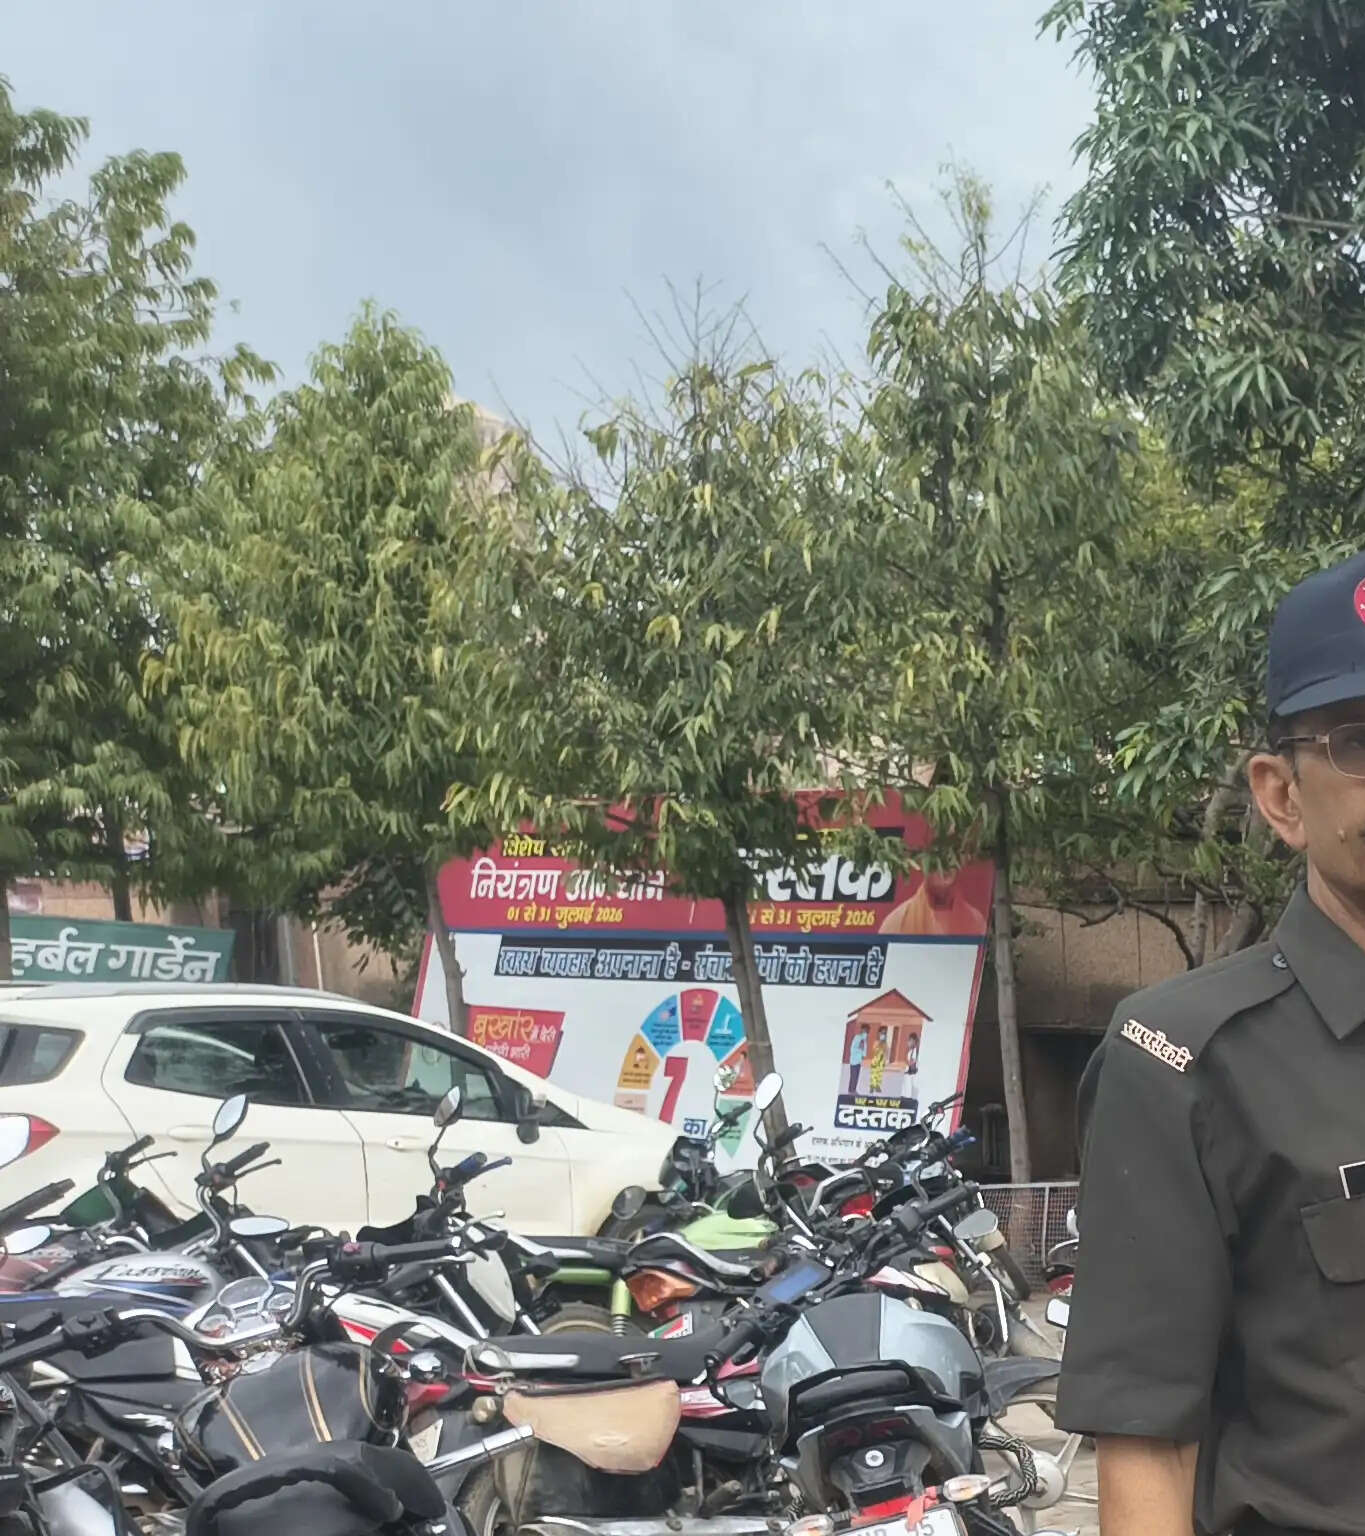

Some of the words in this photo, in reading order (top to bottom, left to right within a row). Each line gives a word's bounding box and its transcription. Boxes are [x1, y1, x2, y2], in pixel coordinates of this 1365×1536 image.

[469, 856, 562, 900] नियंत्रण
[506, 905, 520, 922] 01
[522, 901, 537, 922] से
[538, 907, 551, 923] 31
[554, 901, 596, 930] जुलाई
[595, 906, 624, 924] 2026
[760, 904, 776, 926] से
[776, 909, 792, 926] 31
[796, 904, 844, 933] जुलाई
[844, 909, 876, 926] 2026
[107, 935, 221, 982] गार्डेन
[595, 949, 666, 979] अपनाना
[664, 942, 682, 980] है
[812, 954, 866, 986] हराना
[865, 946, 885, 987] है
[658, 1055, 690, 1125] 7
[838, 1104, 917, 1130] दस्तक
